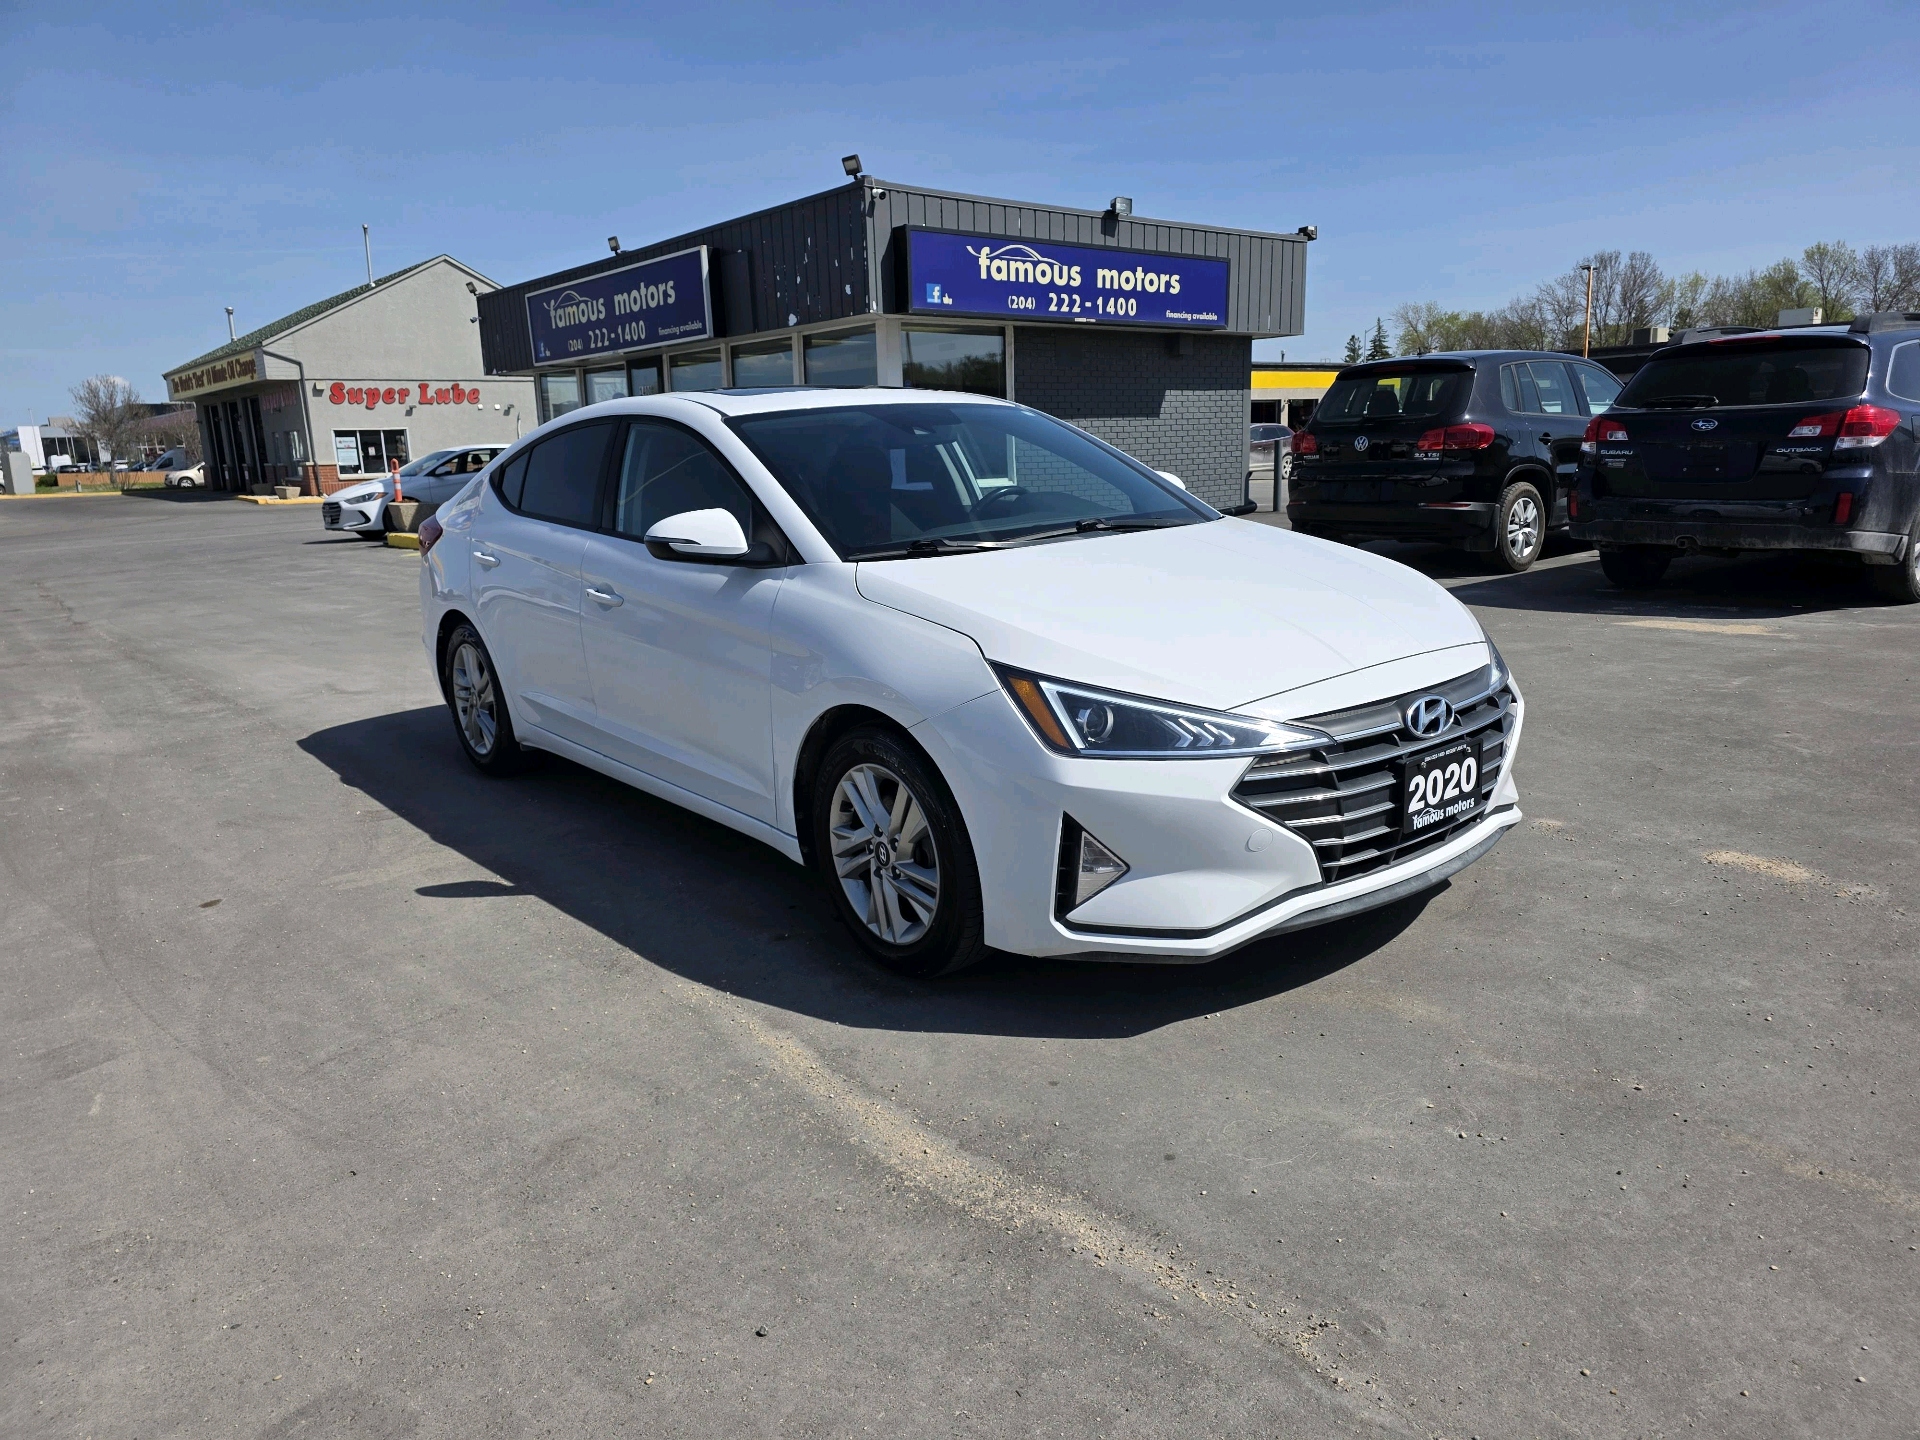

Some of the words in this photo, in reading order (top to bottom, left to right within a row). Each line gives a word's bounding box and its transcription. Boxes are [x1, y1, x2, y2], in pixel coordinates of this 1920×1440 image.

[978, 246, 1082, 287] famous
[1096, 266, 1181, 294] motors
[549, 297, 605, 330] famous
[613, 280, 676, 316] motors
[1008, 295, 1036, 310] (204)
[1165, 309, 1192, 321] financing
[1192, 311, 1218, 321] available
[658, 326, 680, 336] financing
[680, 320, 703, 333] available
[567, 338, 584, 352] (204)
[226, 359, 236, 380] Oil
[234, 357, 257, 380] Change
[328, 382, 410, 410] Super
[418, 382, 481, 405] Lube
[1407, 756, 1477, 814] 2020
[1412, 808, 1445, 830] famous
[1445, 797, 1475, 817] motors
